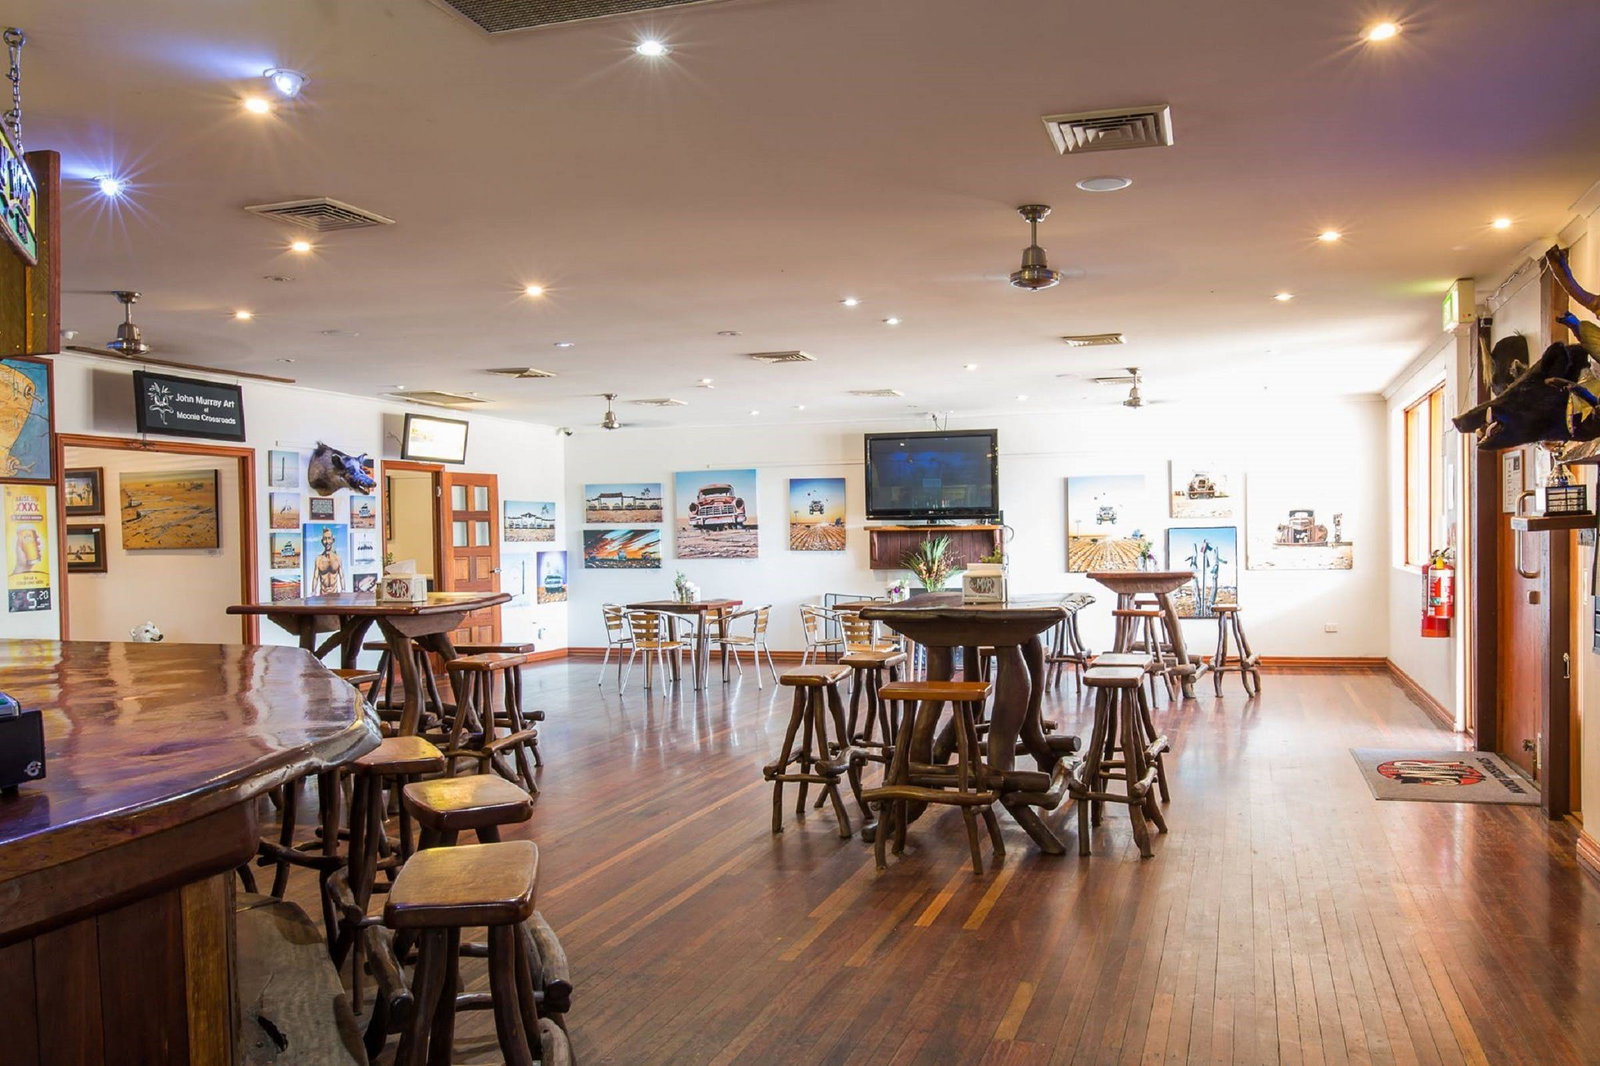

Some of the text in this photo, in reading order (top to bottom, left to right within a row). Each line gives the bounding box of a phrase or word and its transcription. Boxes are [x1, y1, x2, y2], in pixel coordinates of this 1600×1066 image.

[175, 394, 235, 408] John Murray Art
[176, 411, 236, 424] Moonie Crossroads
[16, 502, 39, 511] XXXX
